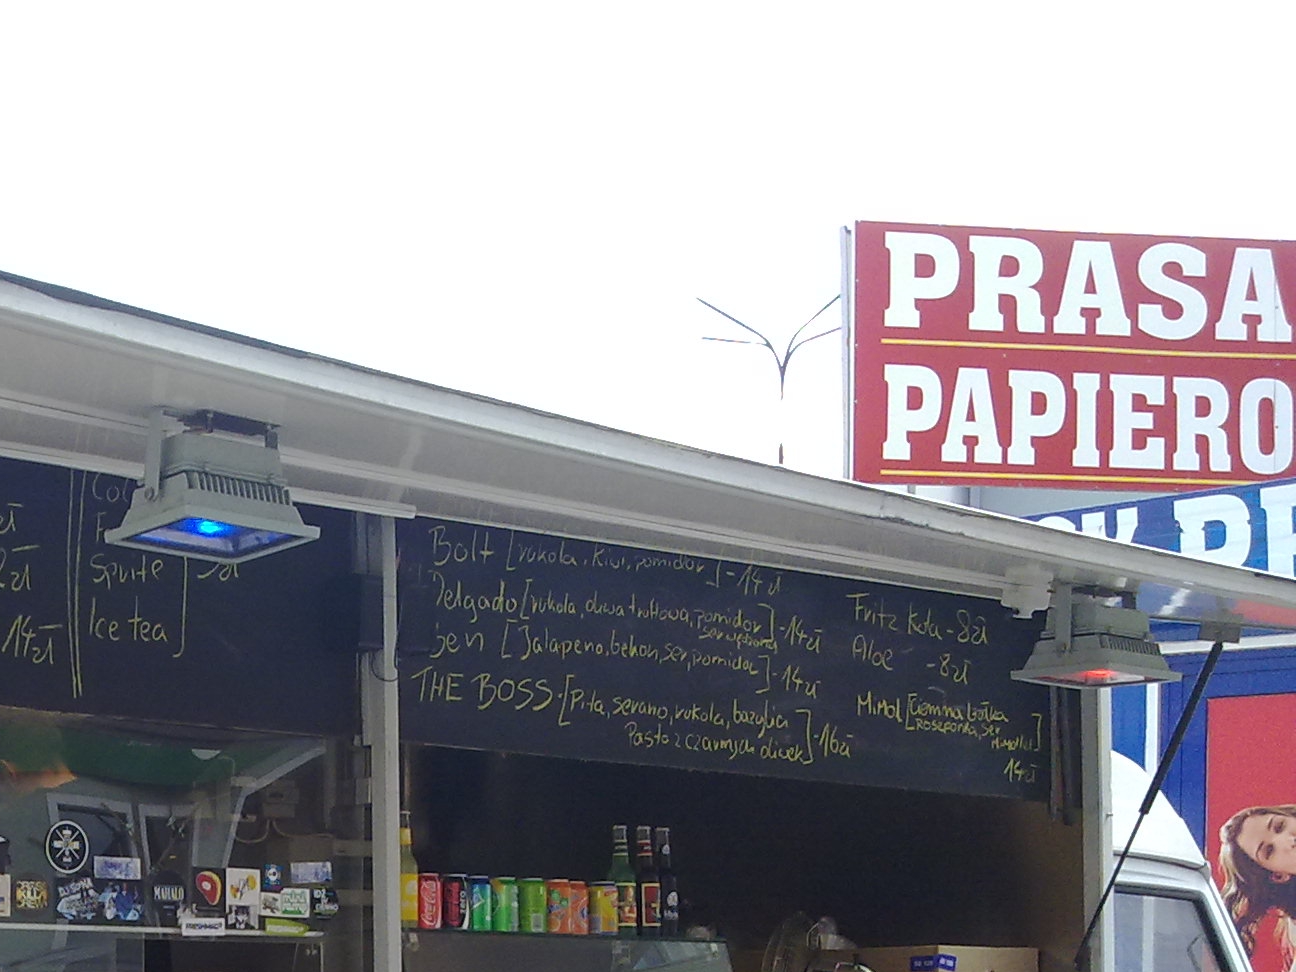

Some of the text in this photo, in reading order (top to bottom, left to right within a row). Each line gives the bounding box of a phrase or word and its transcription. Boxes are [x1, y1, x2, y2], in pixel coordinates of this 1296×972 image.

[882, 230, 1293, 342] PRASA
[429, 525, 494, 566] Bolt
[90, 554, 163, 590] Sprite
[428, 570, 517, 623] Delgado
[846, 593, 898, 631] Fritz
[128, 595, 168, 642] tea
[853, 634, 893, 671] Aloe
[411, 666, 464, 702] THE
[471, 672, 553, 711] BOSS
